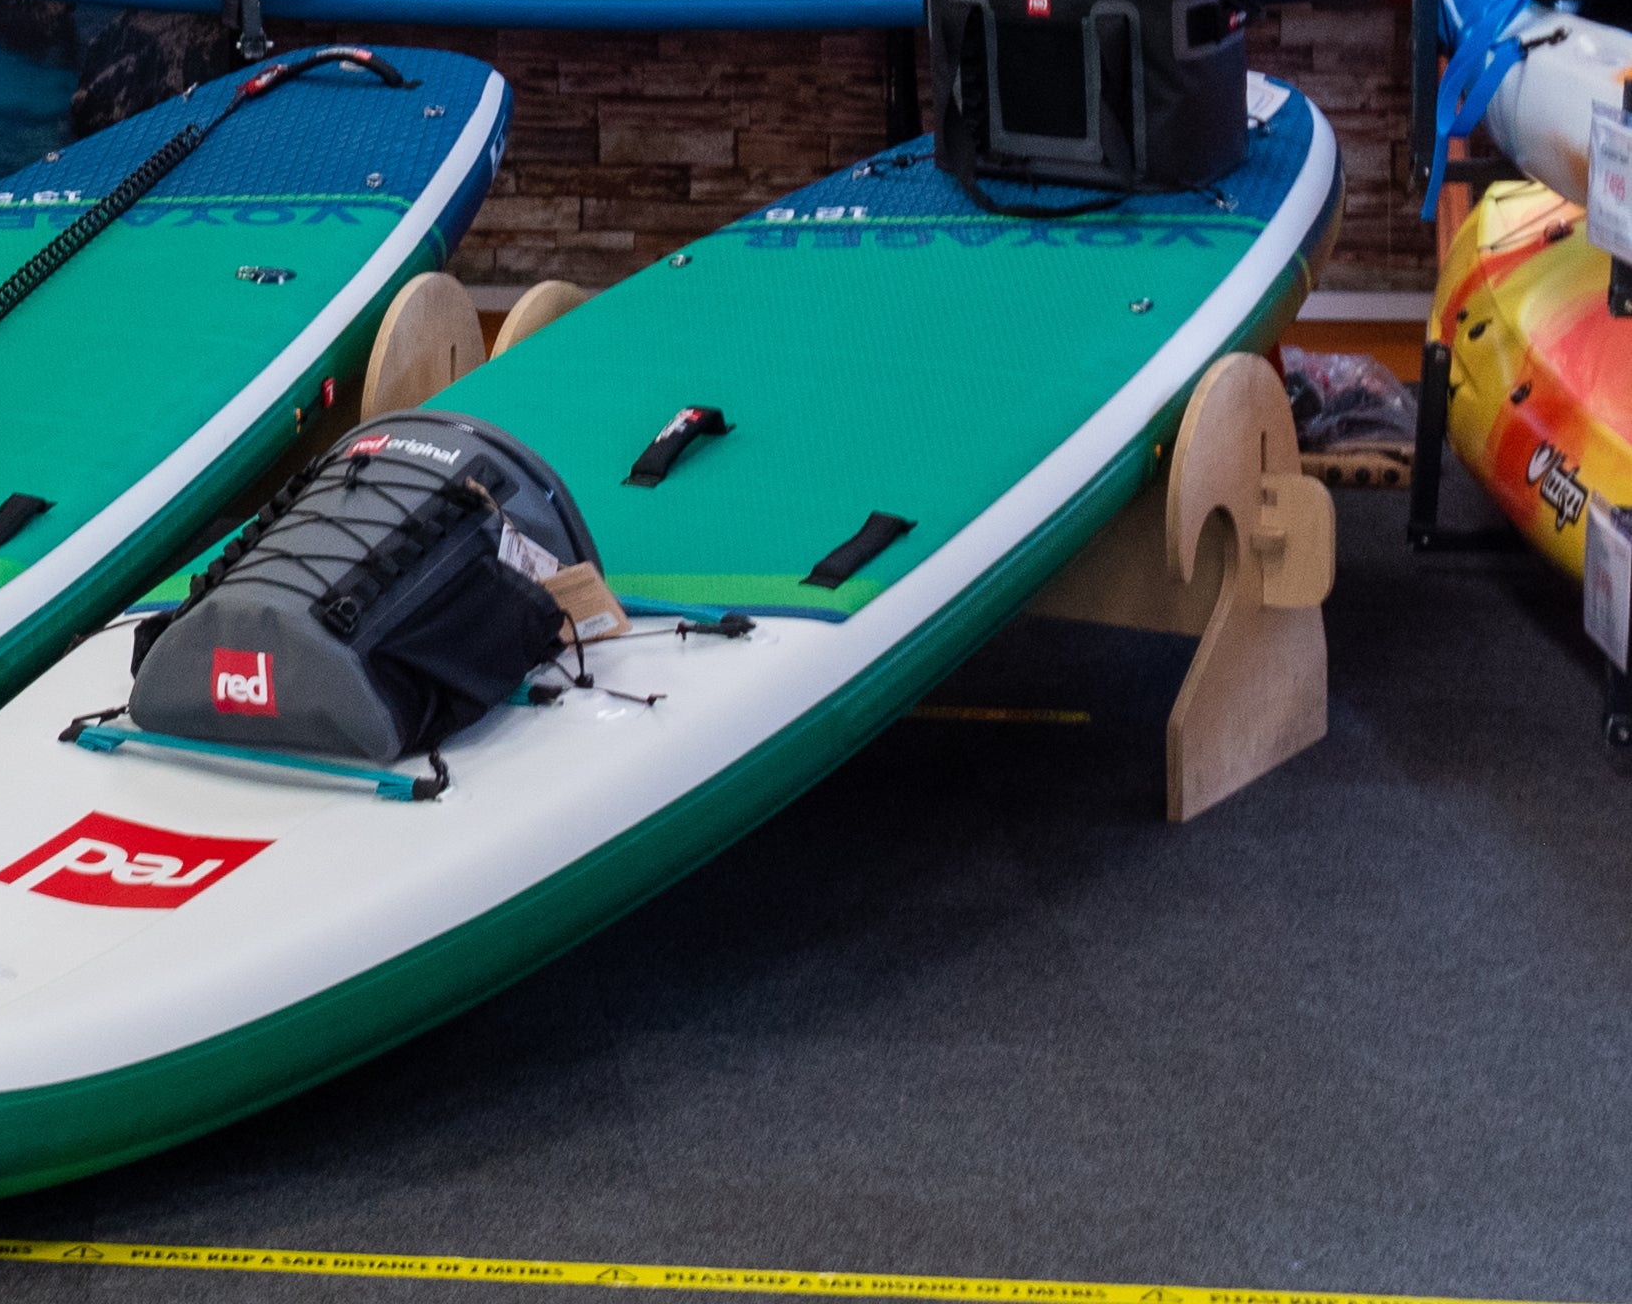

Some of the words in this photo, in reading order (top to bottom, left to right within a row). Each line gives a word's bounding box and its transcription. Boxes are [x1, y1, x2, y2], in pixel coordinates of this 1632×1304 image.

[745, 222, 1216, 250] VOYAGER
[351, 433, 391, 456] red
[387, 436, 461, 465] original
[216, 652, 267, 705] red
[9, 837, 225, 892] red
[129, 1249, 203, 1261] PLEASE
[206, 1251, 257, 1264] KEEP
[280, 1255, 327, 1267] SAFE
[332, 1257, 430, 1271] DISTANCE
[436, 1261, 464, 1273] OF
[485, 1264, 565, 1277] METRES
